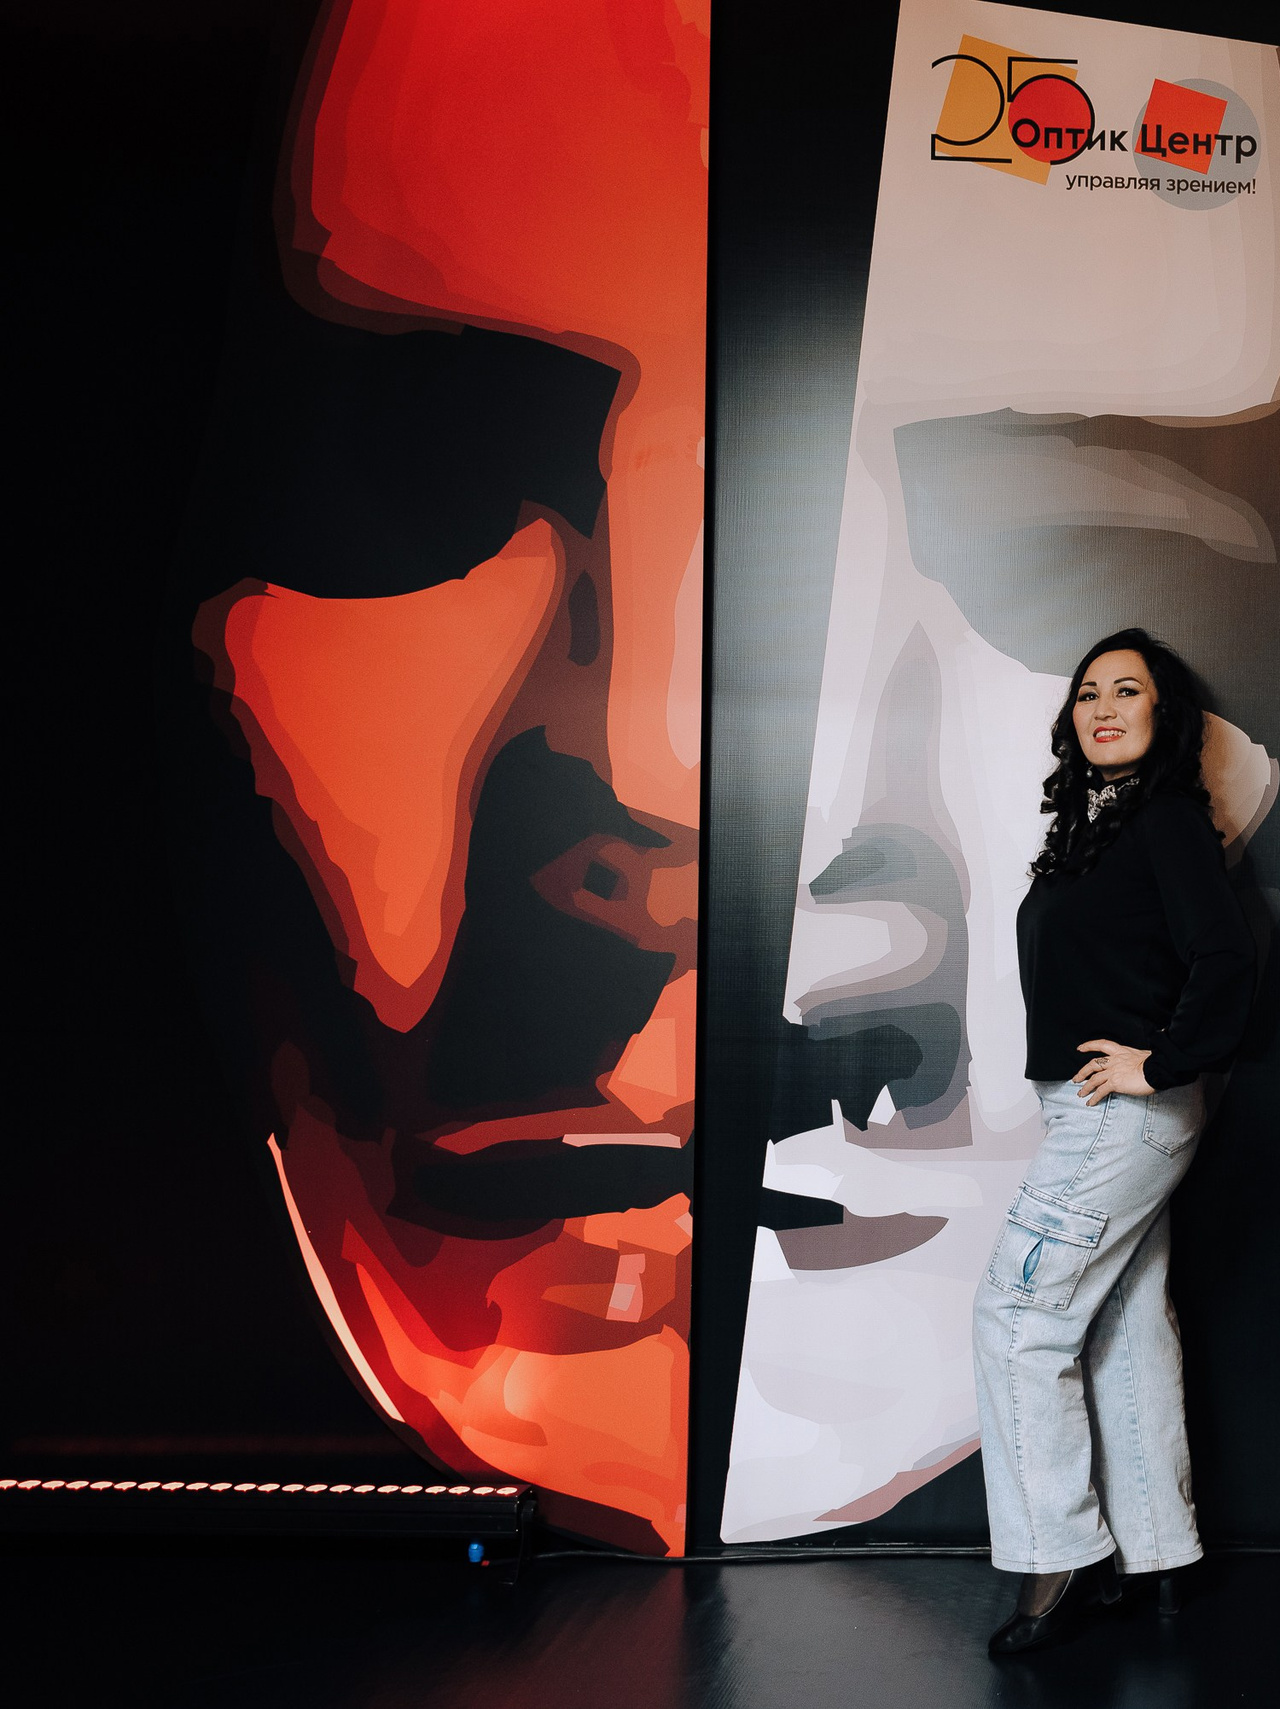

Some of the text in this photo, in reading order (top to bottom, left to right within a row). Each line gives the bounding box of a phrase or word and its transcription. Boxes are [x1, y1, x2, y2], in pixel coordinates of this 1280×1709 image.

[931, 54, 1095, 165] 25
[1012, 118, 1257, 164] Оптик Центр
[1065, 173, 1257, 195] управляя зрением!
